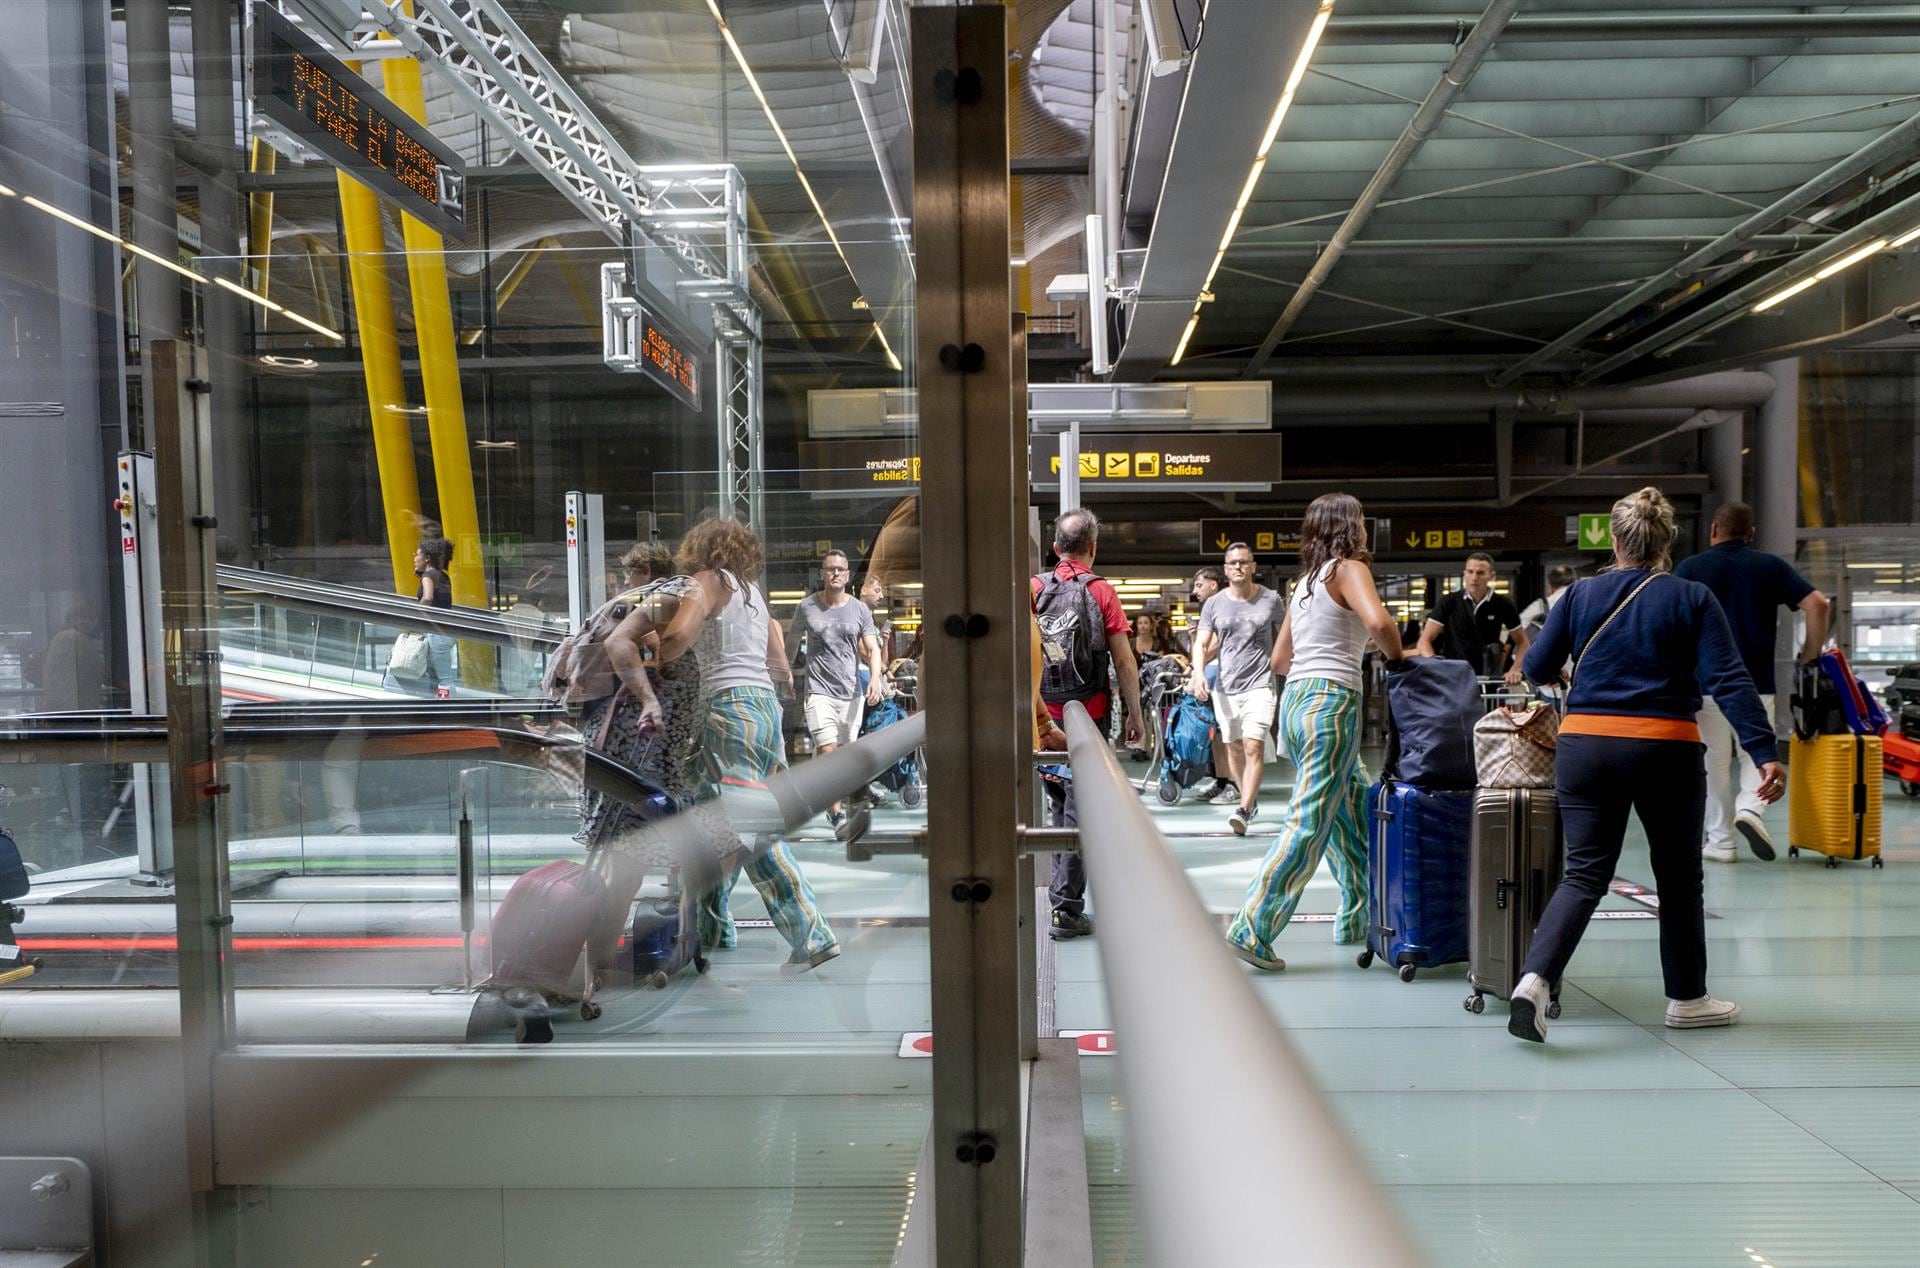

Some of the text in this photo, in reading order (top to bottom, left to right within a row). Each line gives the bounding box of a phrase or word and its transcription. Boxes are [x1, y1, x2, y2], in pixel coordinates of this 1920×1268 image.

[294, 53, 438, 179] SUELTE LA BARRA
[294, 84, 438, 204] Y PARE EL CARRO
[648, 327, 672, 359] RELEASE
[1165, 453, 1211, 464] Departures
[1165, 464, 1204, 476] Salidas
